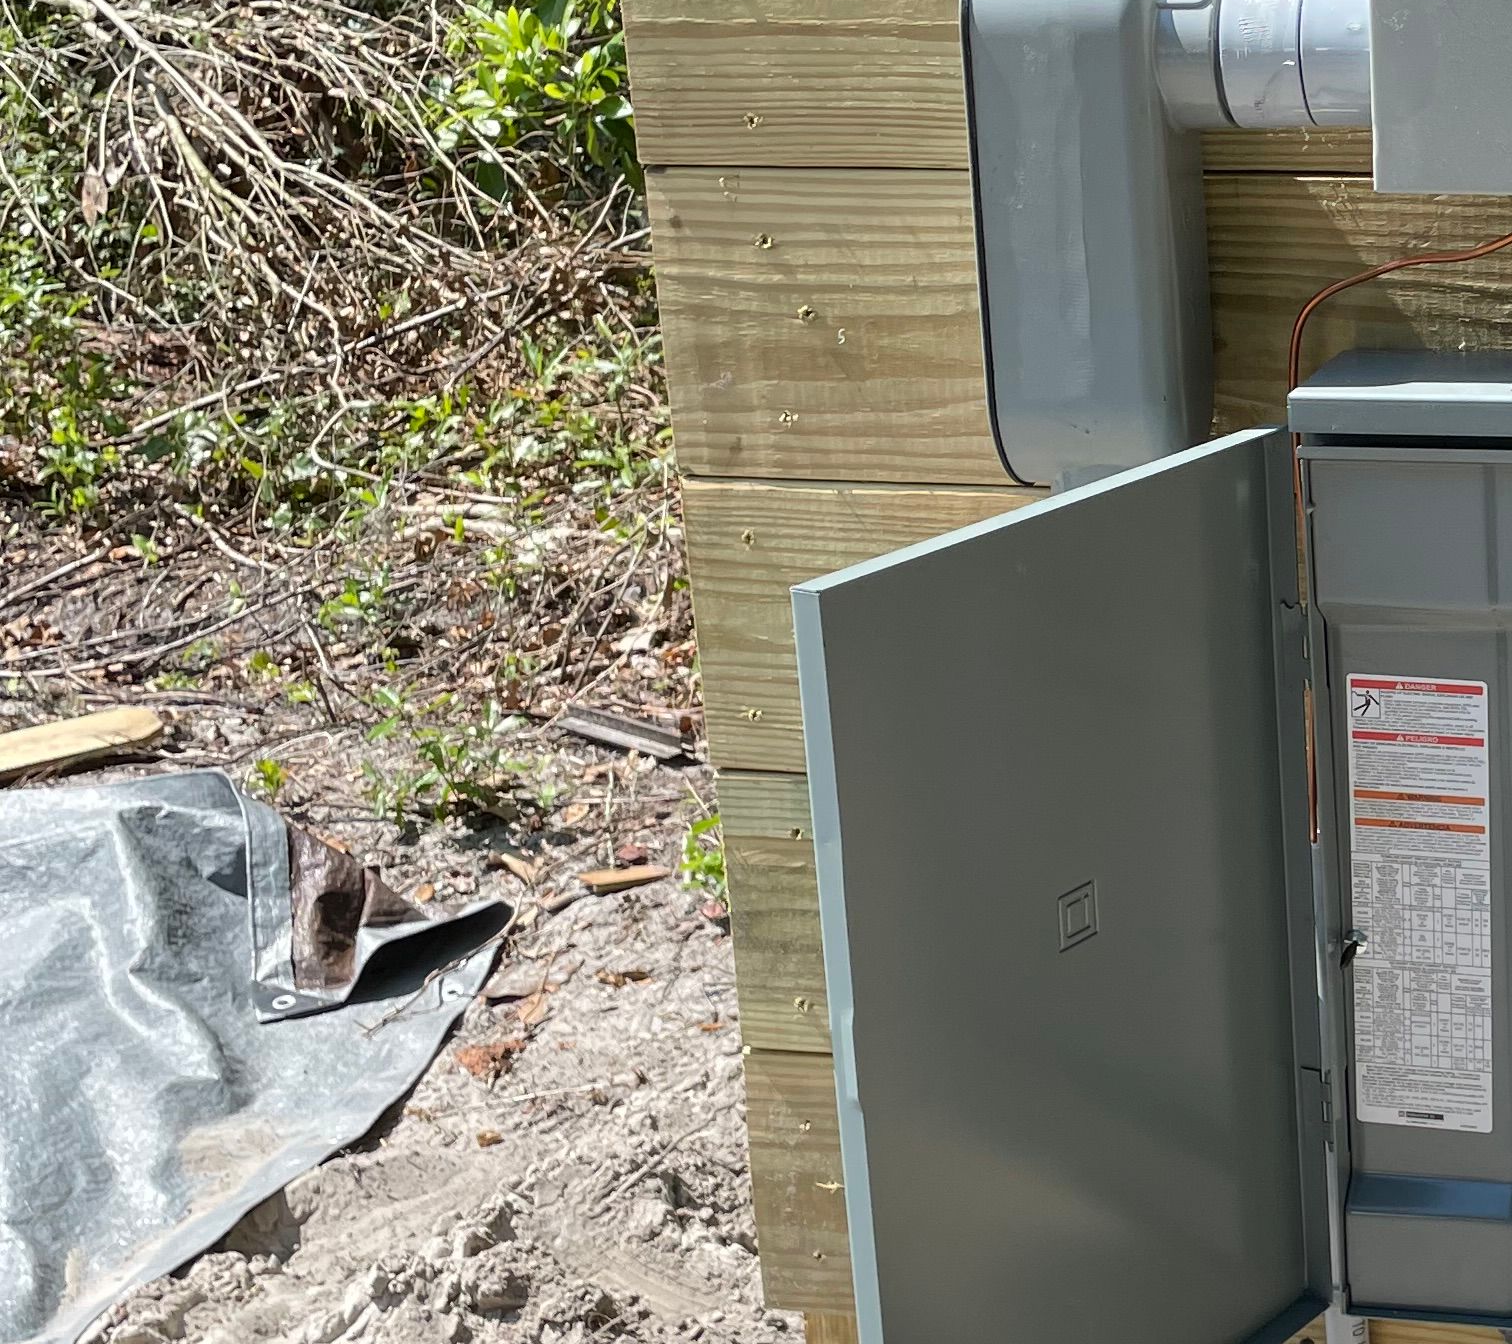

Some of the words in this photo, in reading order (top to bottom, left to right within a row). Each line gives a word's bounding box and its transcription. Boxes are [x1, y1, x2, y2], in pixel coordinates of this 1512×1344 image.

[1404, 683, 1437, 691] DANGER
[1405, 735, 1439, 744] PELIGRO
[1352, 1319, 1366, 1337] TO
